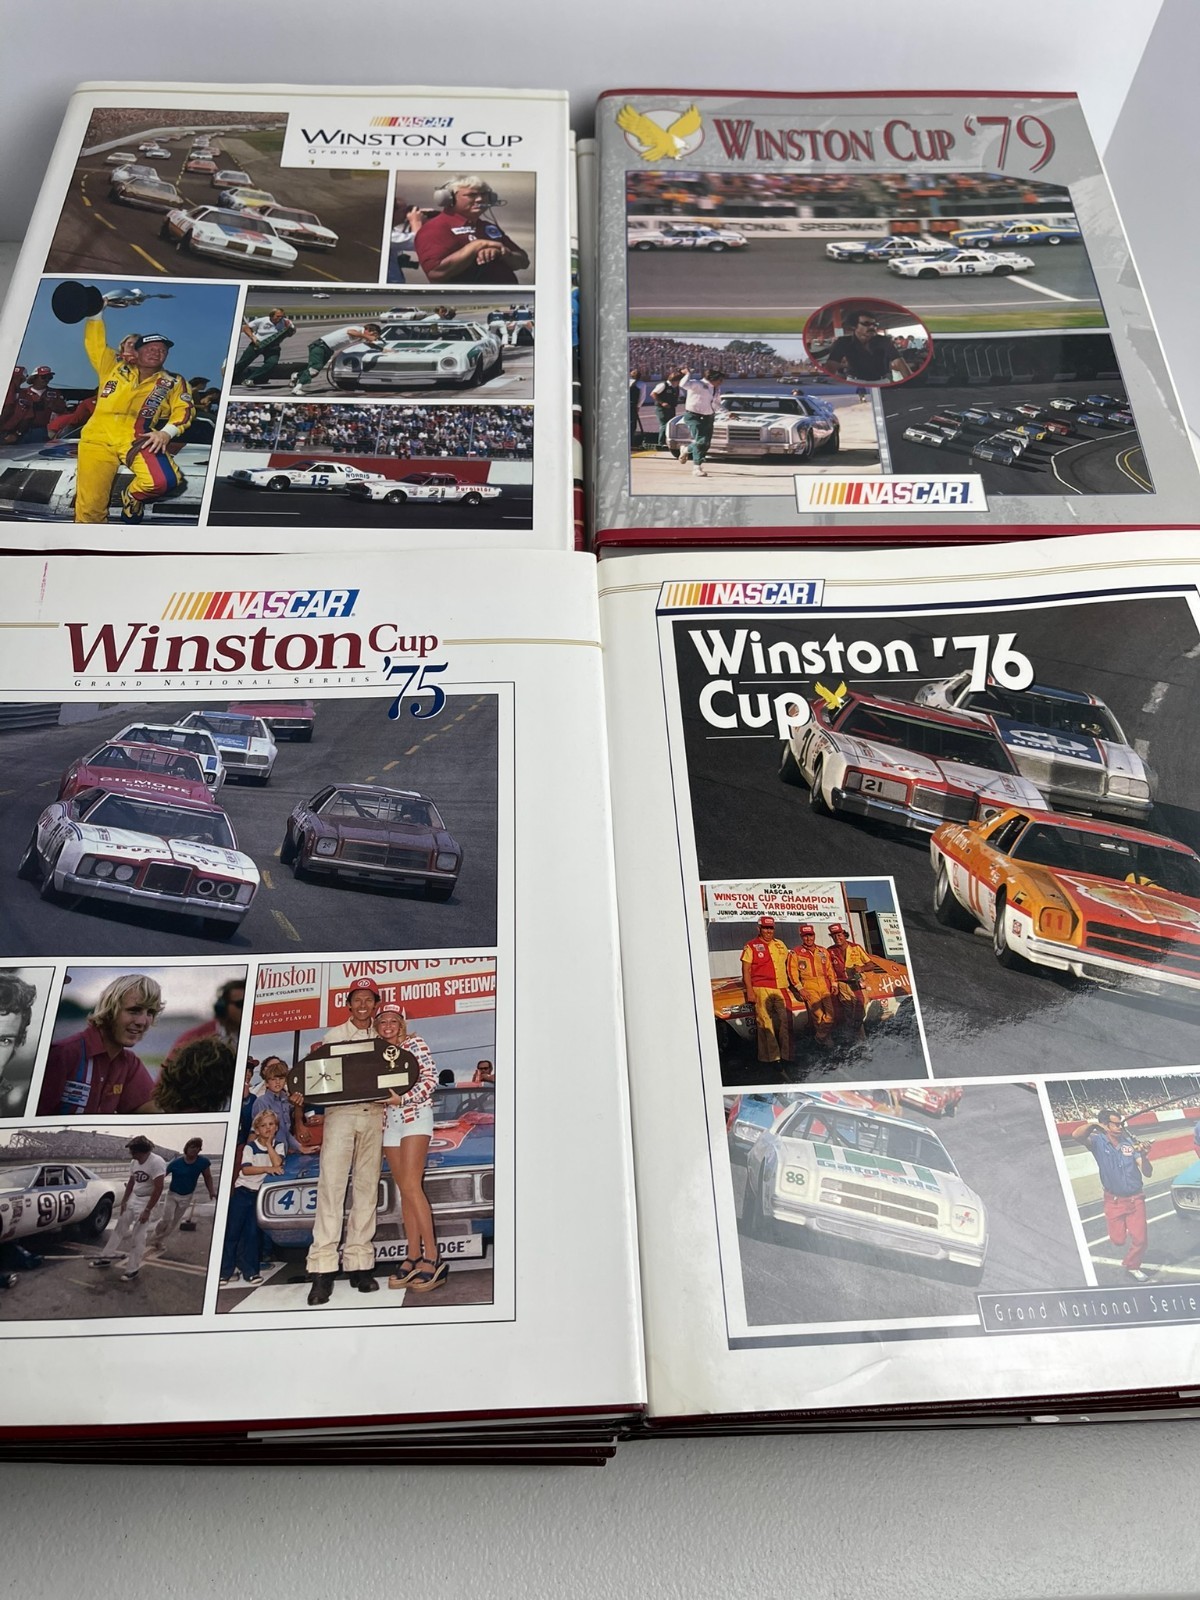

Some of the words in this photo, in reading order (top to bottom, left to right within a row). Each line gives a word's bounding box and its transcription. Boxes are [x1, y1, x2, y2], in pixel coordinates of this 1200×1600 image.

[395, 116, 453, 128] NASCAR
[957, 264, 976, 274] 15
[310, 475, 331, 487] 15
[427, 487, 447, 499] 21
[860, 482, 964, 504] NASCAR
[712, 582, 812, 605] NASCAR
[220, 590, 354, 619] NASCAR
[64, 622, 366, 673] Winston
[368, 623, 439, 658] Cup
[687, 628, 920, 676] Winston
[931, 631, 1035, 693] '76
[74, 679, 142, 687] GRAND
[164, 678, 272, 687] NATIONAL
[293, 676, 370, 685] SERIES
[382, 655, 449, 720] '75
[698, 678, 812, 741] Cup
[99, 776, 192, 795] GILMORE
[864, 779, 883, 793] 21
[713, 893, 755, 902] WINSTON
[758, 894, 778, 903] CUP
[781, 895, 835, 904] CHAMPION
[735, 902, 758, 910] CALE
[763, 902, 819, 911] YARBOROUGH
[1045, 912, 1064, 931] 11
[257, 965, 316, 990] Winston
[343, 960, 420, 978] WINSTON
[400, 981, 441, 1002] MOTOR
[444, 974, 496, 996] SPEEDWA
[882, 974, 910, 993] Holl
[254, 1017, 284, 1026] OBACCO
[285, 1013, 312, 1022] FLAVOR
[785, 1170, 806, 1187] 88
[36, 1189, 76, 1228] 96
[994, 1301, 1048, 1322] Grand
[1058, 1296, 1140, 1318] National
[1149, 1294, 1197, 1314] Serie
